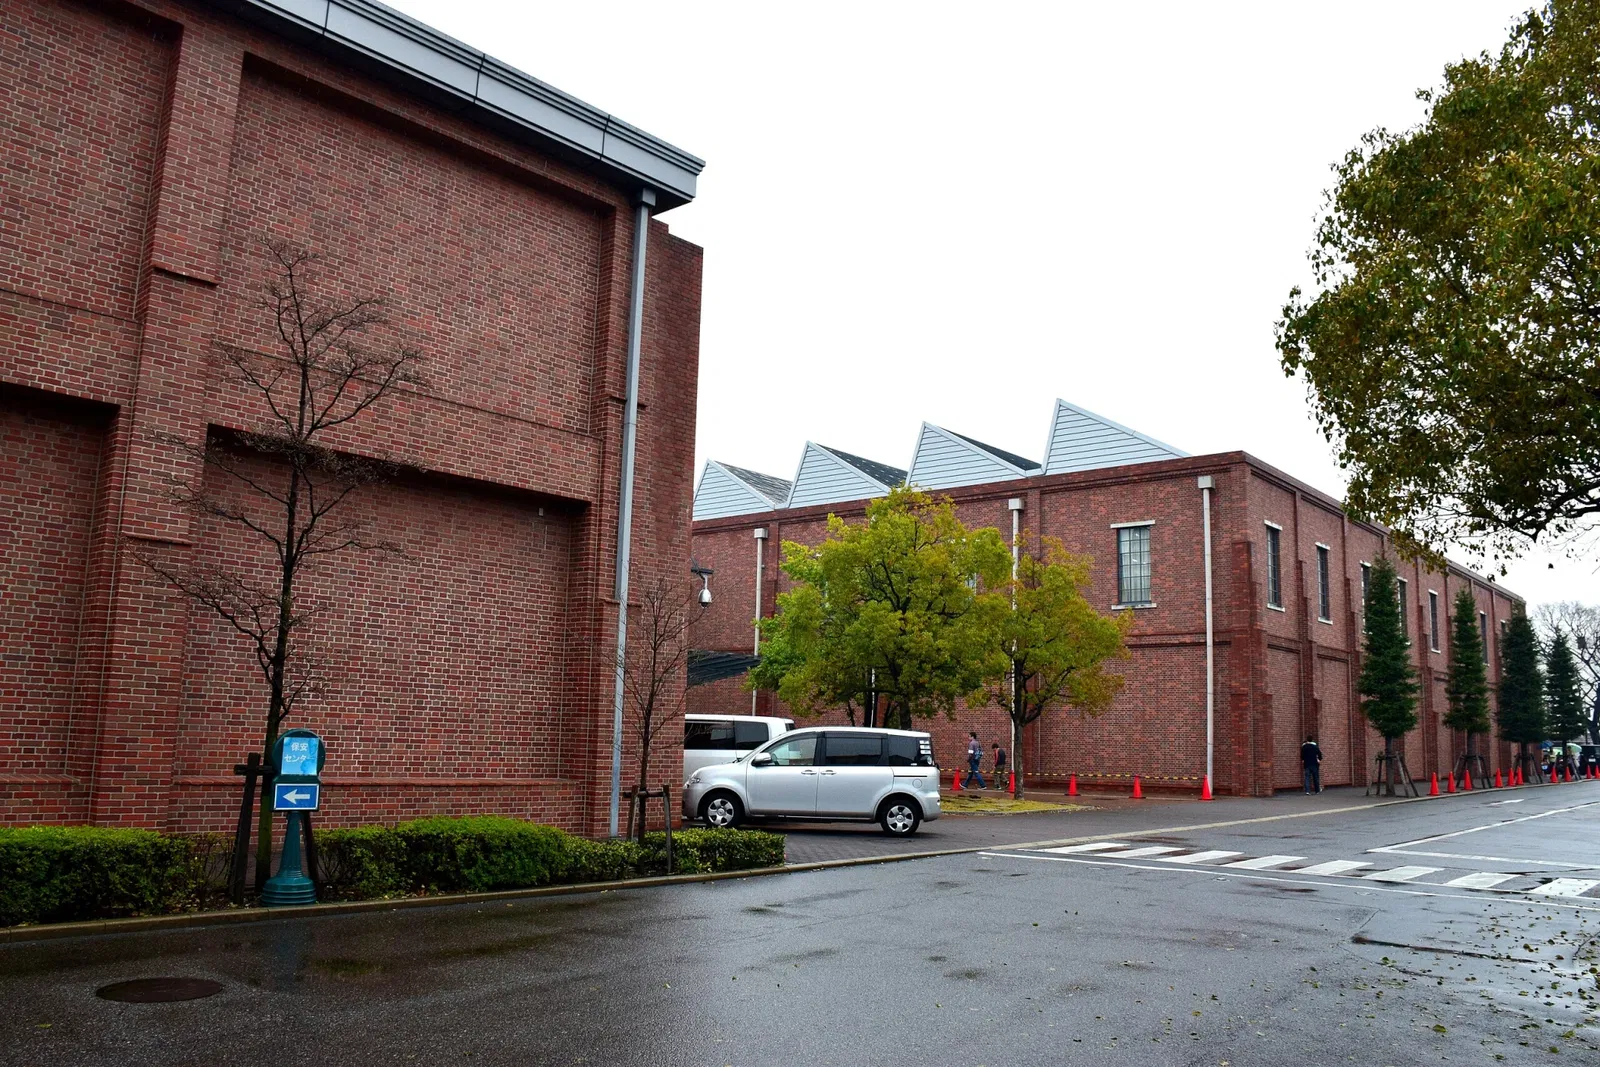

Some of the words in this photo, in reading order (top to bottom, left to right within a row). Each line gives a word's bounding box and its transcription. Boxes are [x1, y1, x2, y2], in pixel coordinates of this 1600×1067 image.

[291, 742, 308, 751] 保安
[284, 754, 315, 763] センター
